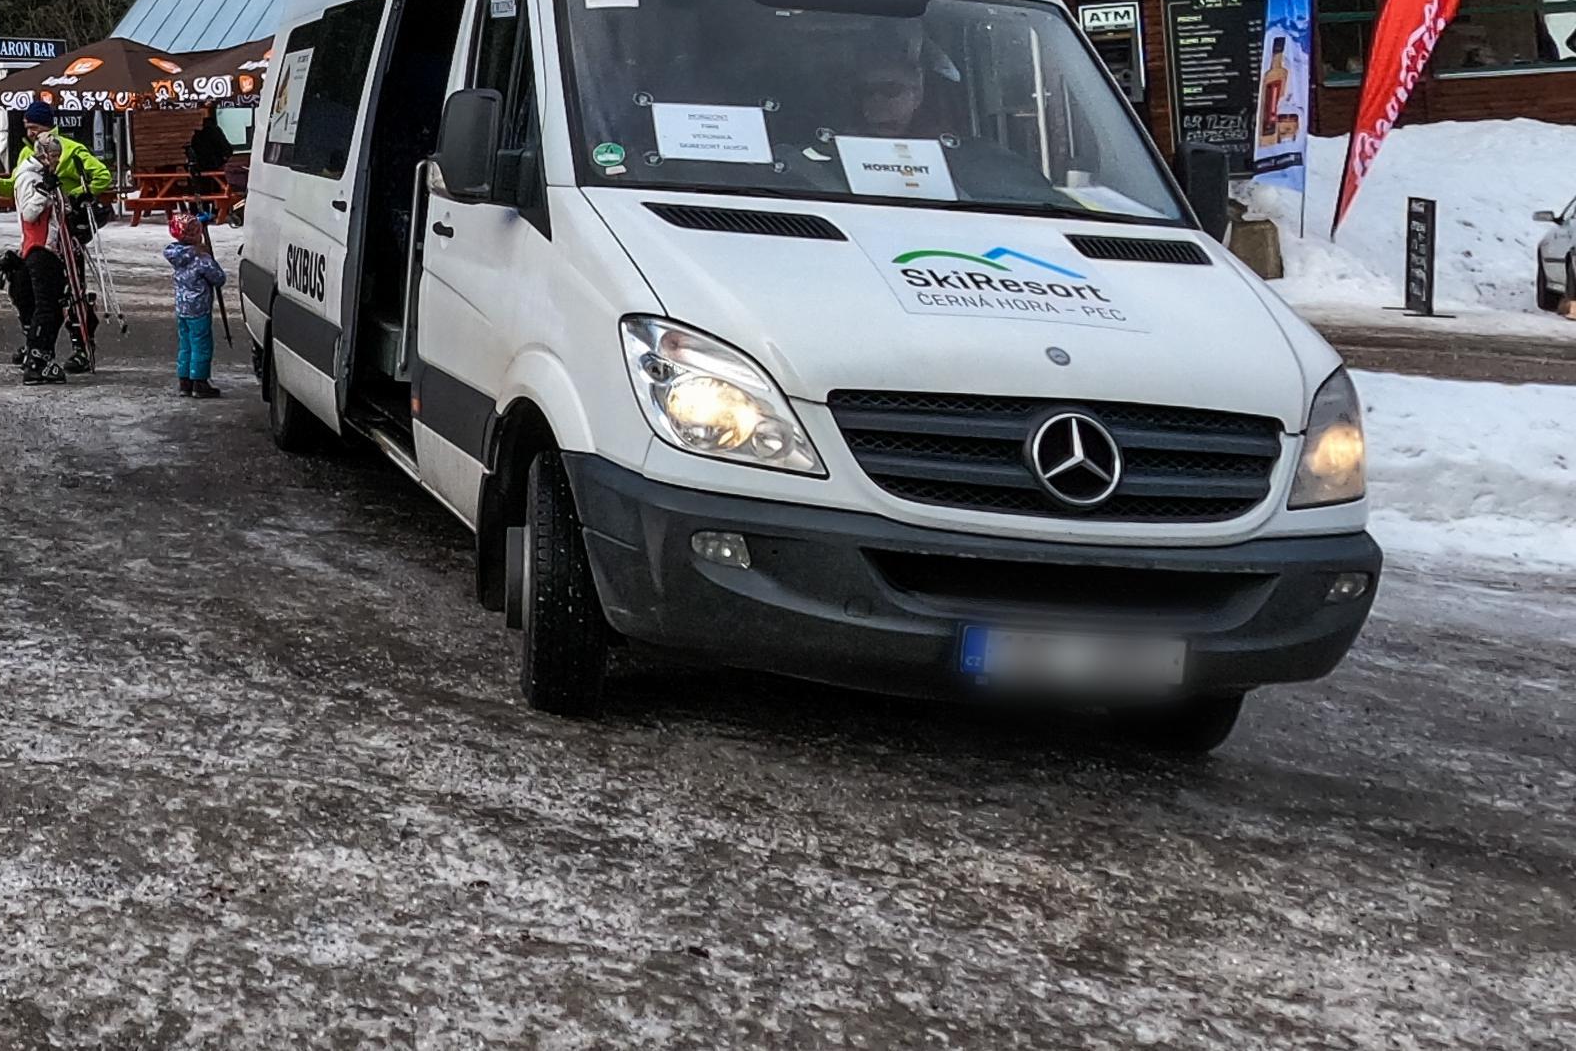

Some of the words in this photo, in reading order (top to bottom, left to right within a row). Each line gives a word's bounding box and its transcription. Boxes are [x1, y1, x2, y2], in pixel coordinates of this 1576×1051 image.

[1089, 9, 1131, 23] ATM
[33, 41, 56, 58] BAR
[861, 162, 930, 175] HORIZONT
[285, 242, 326, 303] SKIBUS
[900, 267, 1112, 303] SkiResort
[917, 292, 989, 309] ČERNÁ
[996, 298, 1059, 315] HORA
[1083, 306, 1127, 322] PEC
